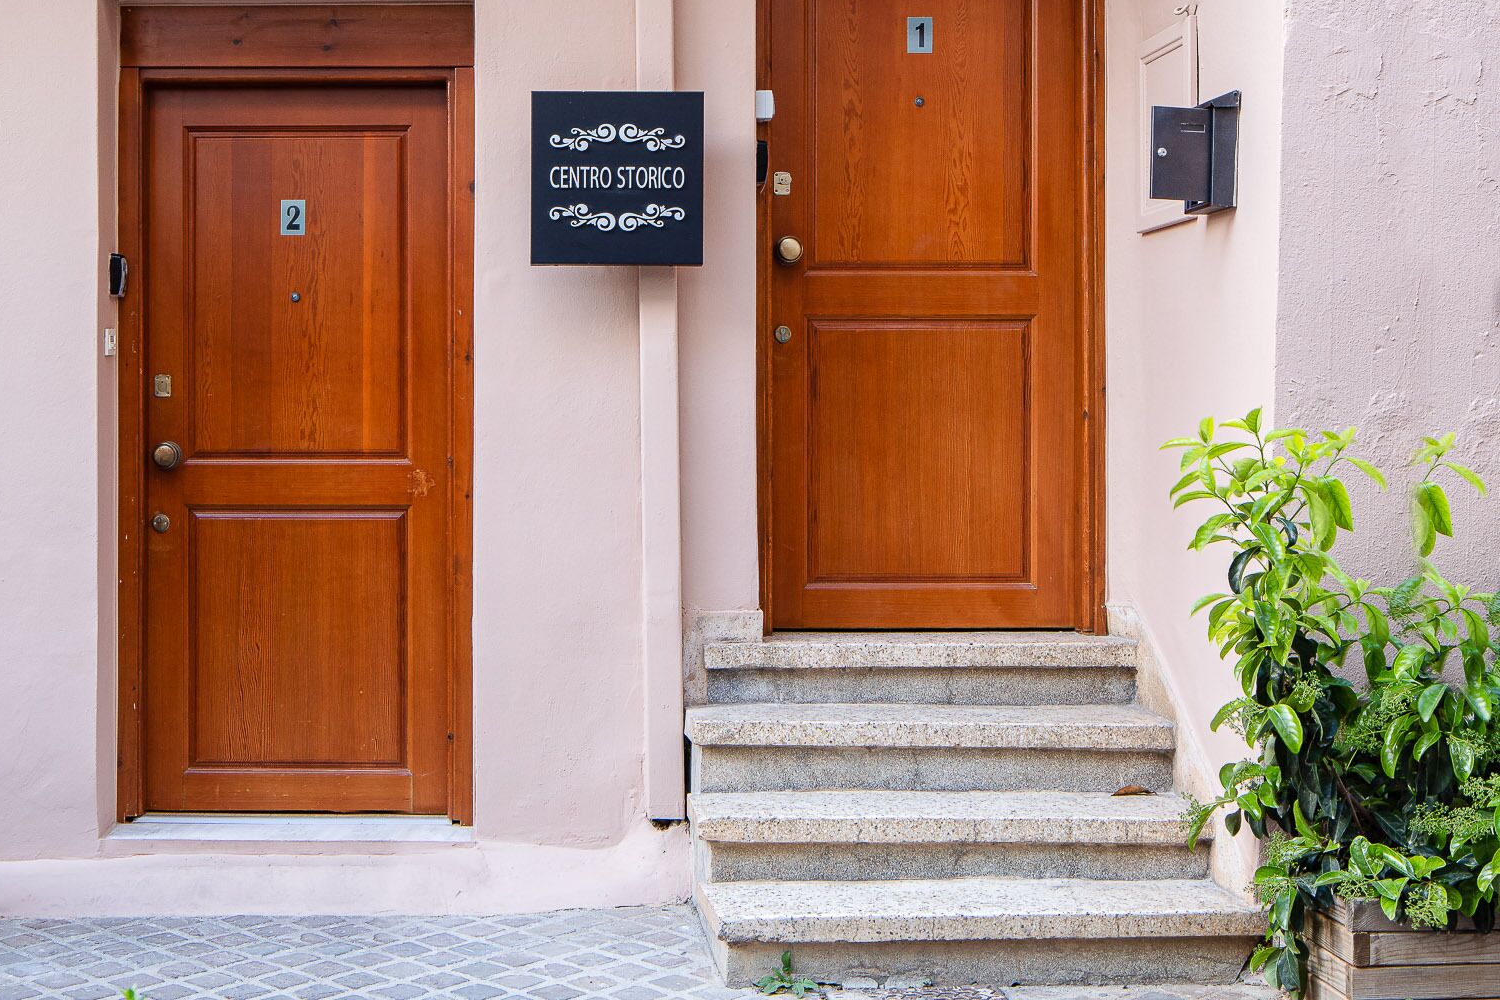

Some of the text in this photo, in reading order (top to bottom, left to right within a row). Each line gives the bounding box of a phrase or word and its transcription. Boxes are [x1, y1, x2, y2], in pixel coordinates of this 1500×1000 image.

[915, 22, 925, 48] 1
[550, 166, 685, 189] CENTRO STORICO
[286, 205, 301, 231] 2
